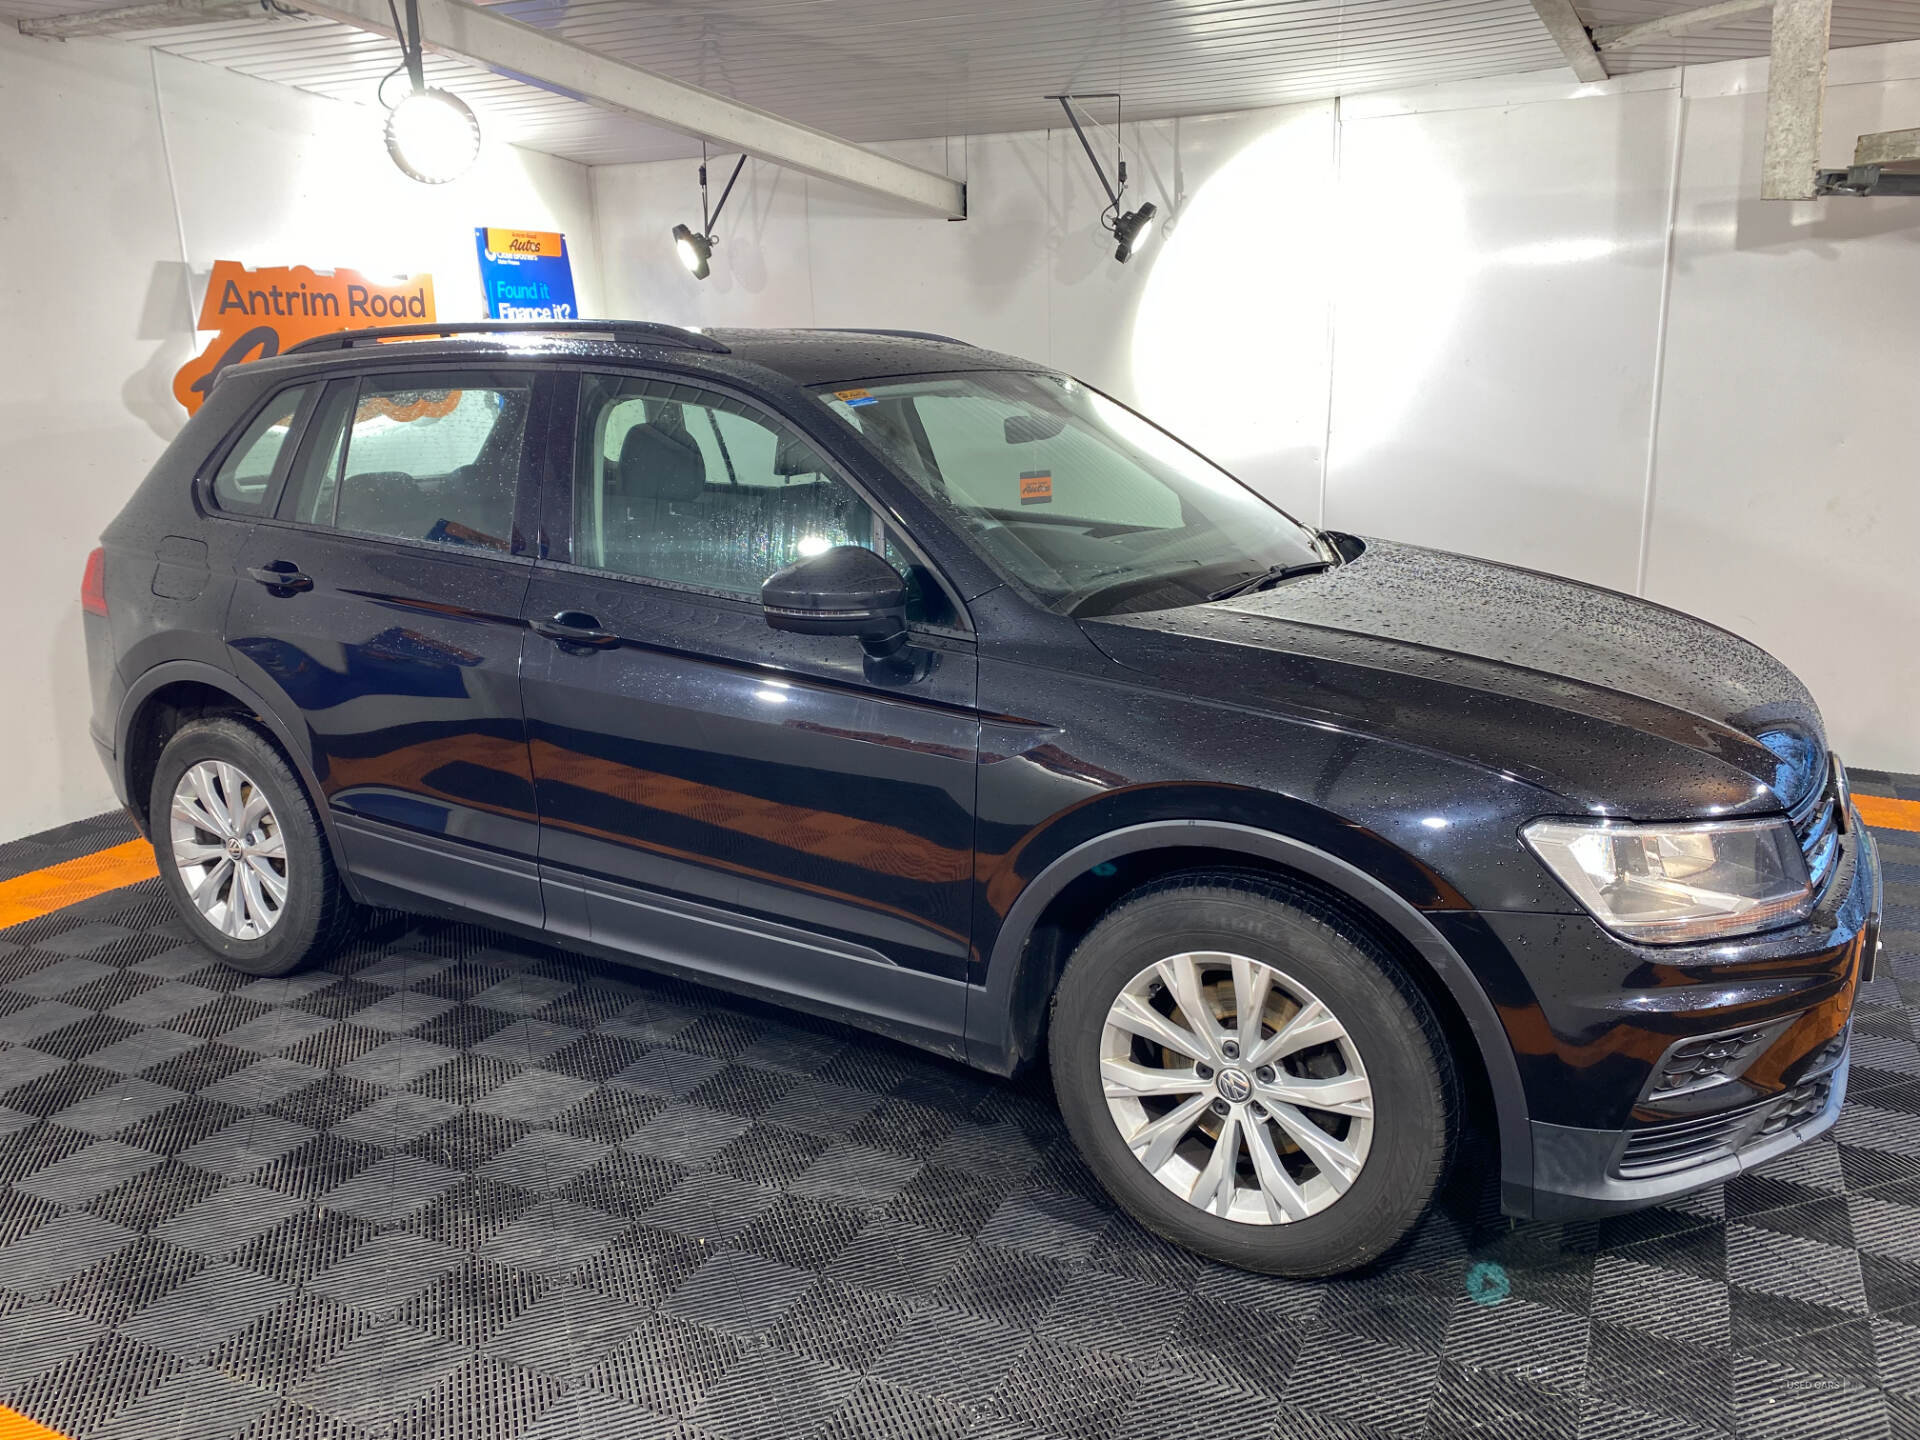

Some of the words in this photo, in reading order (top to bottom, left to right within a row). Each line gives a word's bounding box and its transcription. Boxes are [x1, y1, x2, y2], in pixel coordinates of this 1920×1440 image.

[509, 238, 541, 252] Autos
[219, 279, 339, 317] Antrim
[347, 284, 426, 318] Road
[496, 280, 538, 299] Found
[539, 282, 550, 299] it
[498, 302, 551, 320] Finance
[552, 303, 570, 320] it?
